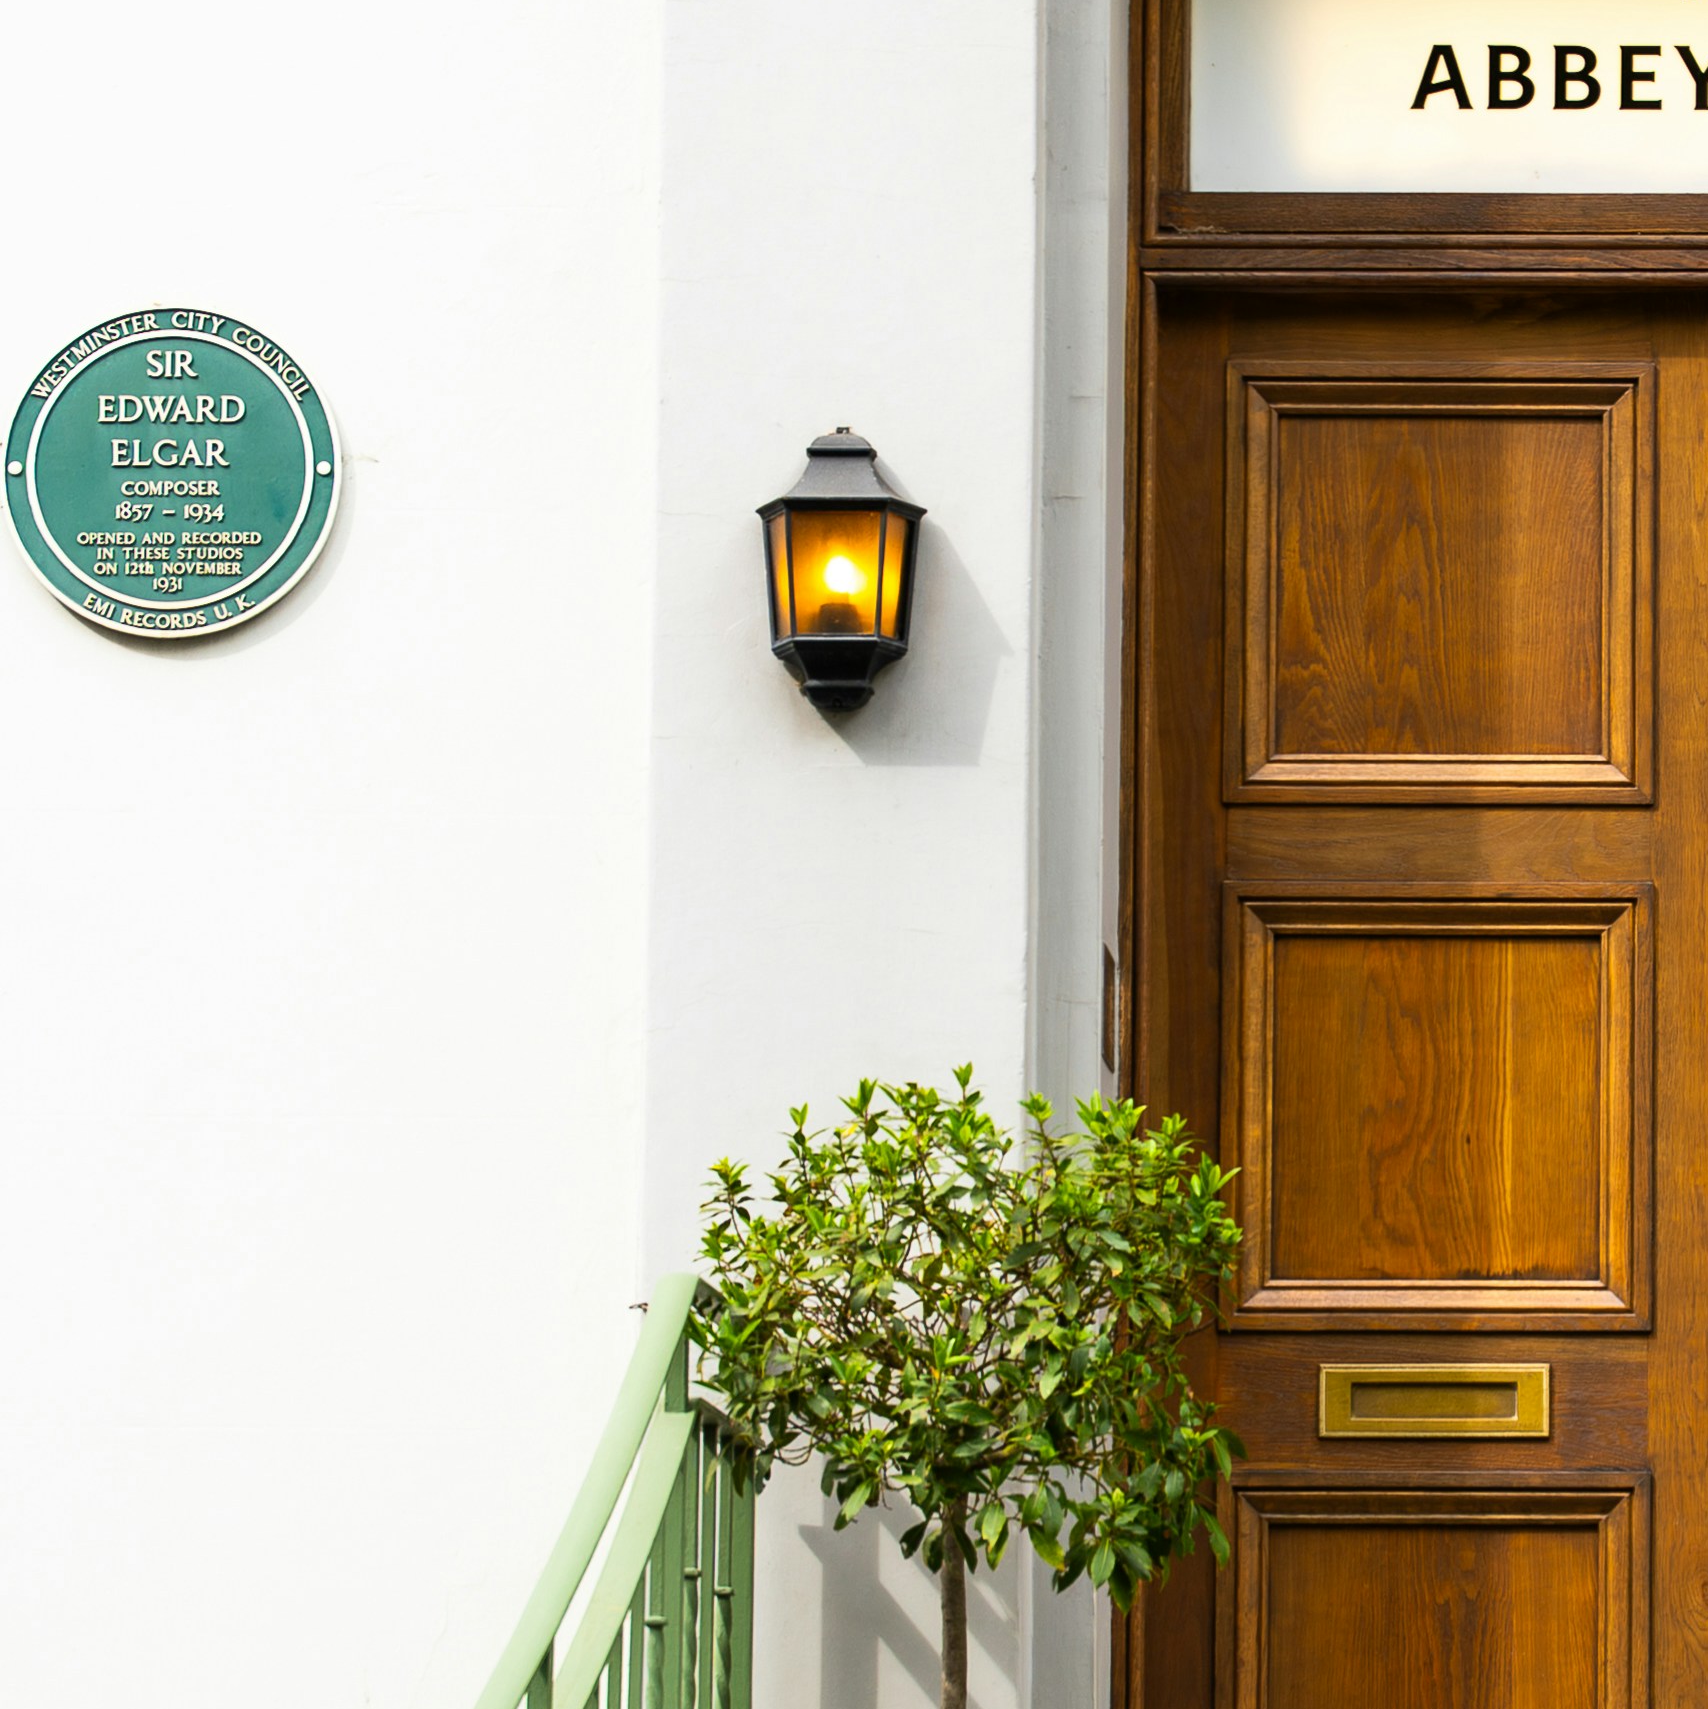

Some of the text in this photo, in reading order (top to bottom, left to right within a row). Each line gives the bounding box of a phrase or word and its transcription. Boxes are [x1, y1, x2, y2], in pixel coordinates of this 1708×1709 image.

[31, 311, 311, 402] WESTMINSTER CITY COUNCIL
[146, 350, 199, 379] SIR
[97, 395, 246, 424] EDWARD
[111, 439, 230, 468] ELGAR
[121, 481, 220, 496] COMPOSER
[115, 502, 153, 522] 1857
[184, 503, 225, 522] 1934
[77, 532, 262, 546] OPENED AND RECORDED
[97, 547, 244, 560] IN THESE STUDIOS
[93, 562, 242, 575] ON 12th NOVEMBER
[152, 576, 183, 592] 1931
[82, 592, 116, 624] EMI
[120, 610, 207, 629] RECORDS
